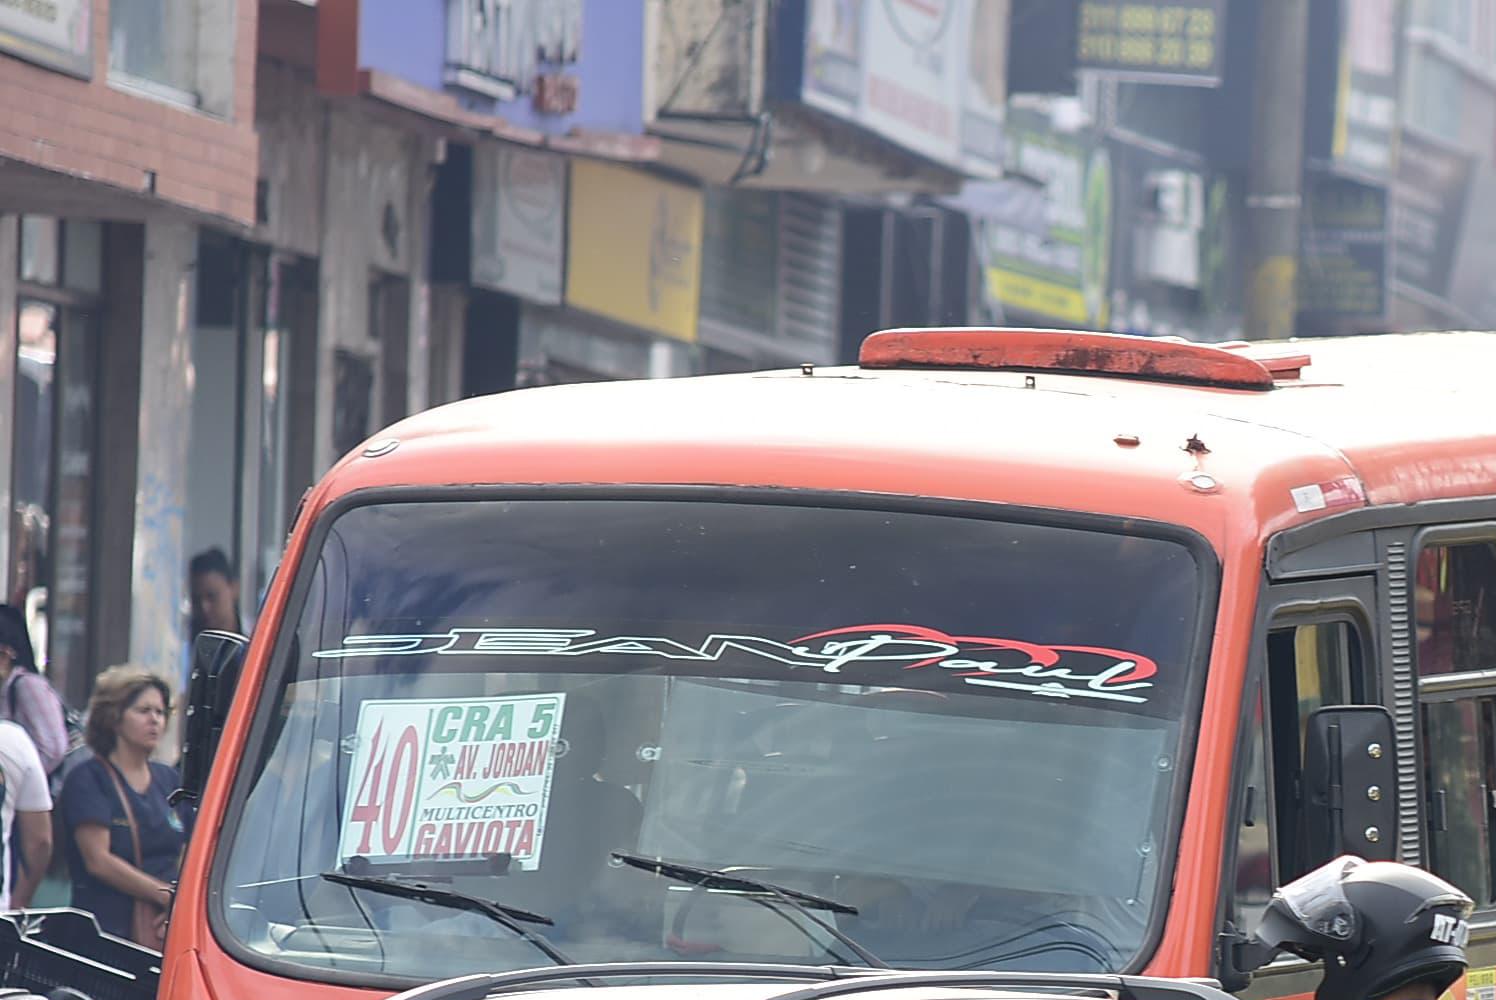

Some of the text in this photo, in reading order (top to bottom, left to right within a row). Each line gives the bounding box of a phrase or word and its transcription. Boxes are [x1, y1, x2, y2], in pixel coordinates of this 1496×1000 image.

[432, 702, 556, 743] CRA 5
[454, 740, 550, 780] AV. JORDAN
[351, 717, 418, 856] 40
[419, 803, 538, 822] MULTICENTRO
[414, 819, 535, 859] GAVIOTA
